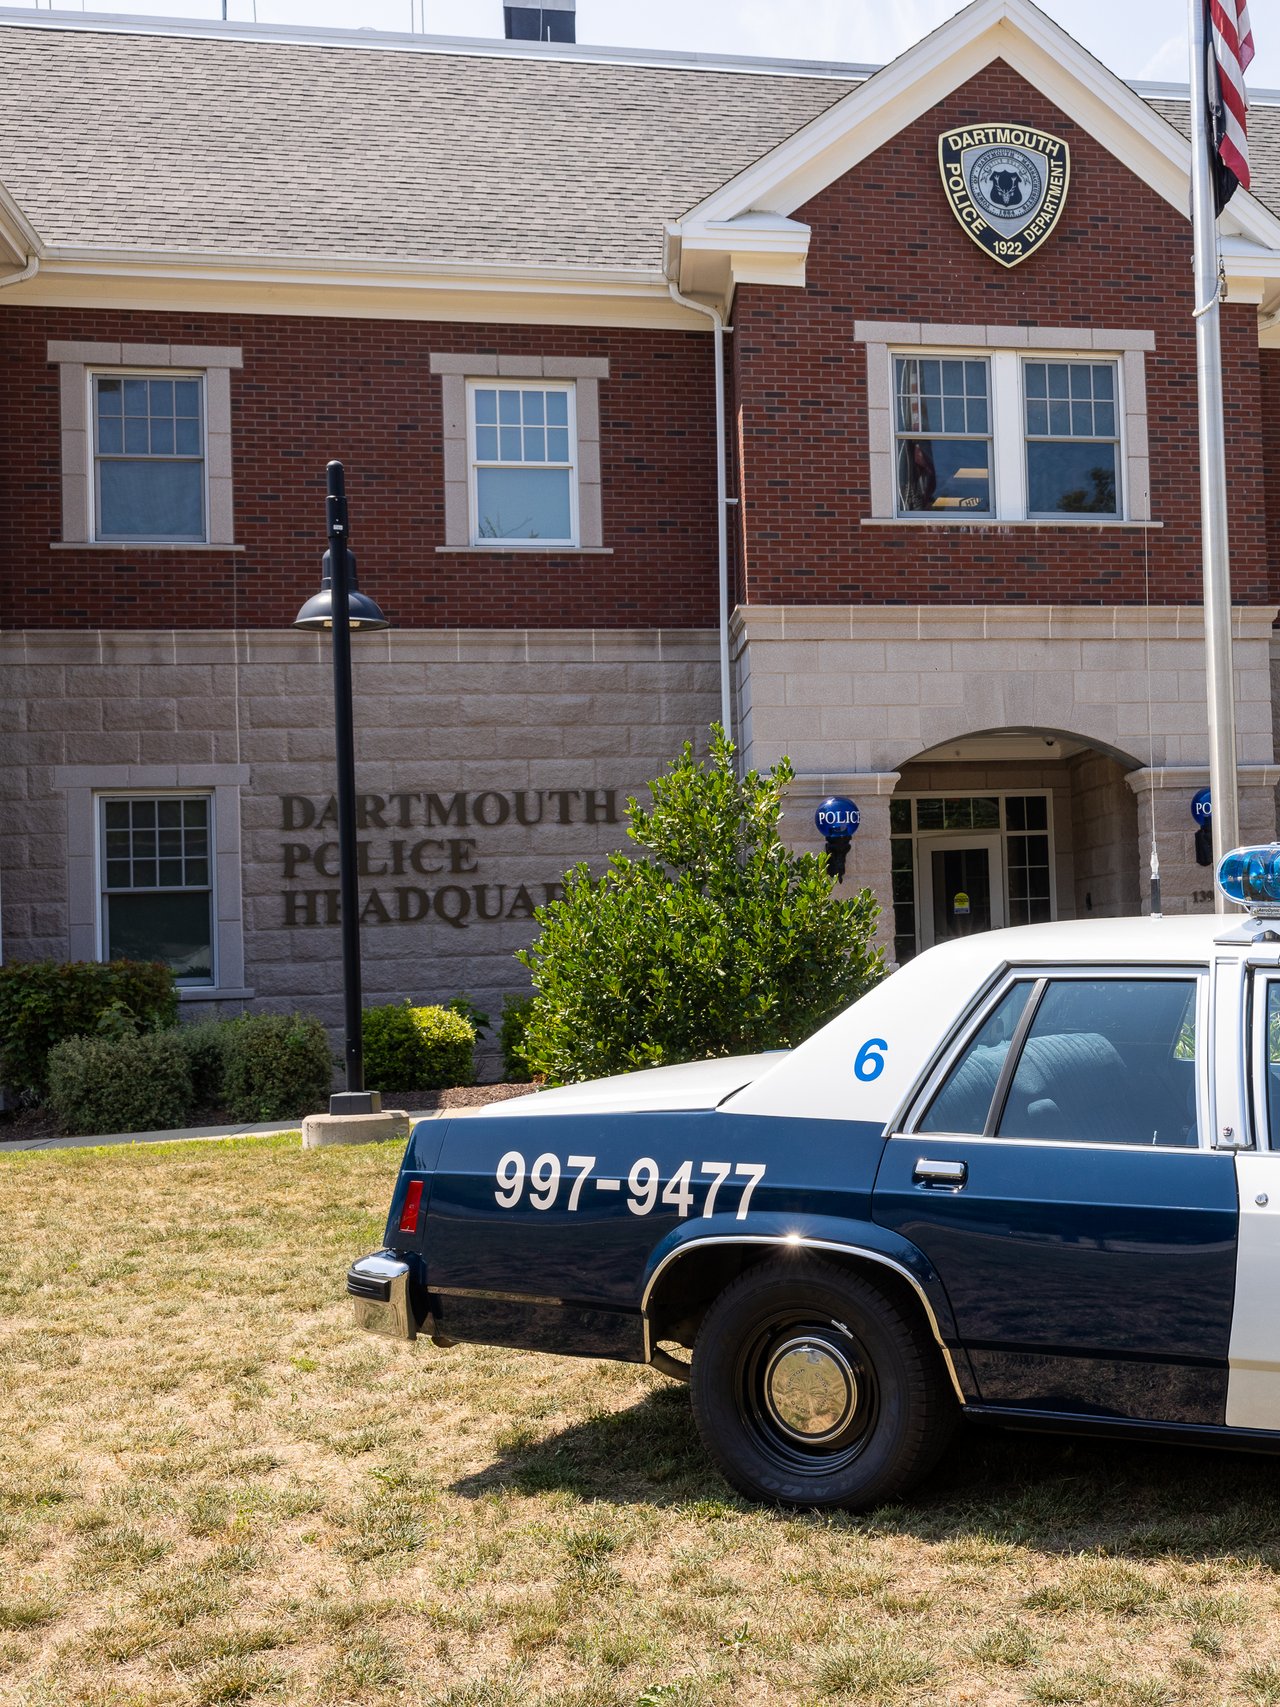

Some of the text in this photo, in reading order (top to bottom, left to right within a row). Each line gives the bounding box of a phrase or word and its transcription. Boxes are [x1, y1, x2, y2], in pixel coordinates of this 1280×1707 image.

[948, 129, 1060, 157] DARTMOUTH
[946, 163, 987, 235] POLICE
[1023, 159, 1063, 243] DEPARTMENT
[993, 241, 1022, 255] 1922
[279, 790, 619, 831] DARTMOUTH
[853, 1037, 889, 1082] 6
[494, 1151, 767, 1220] 997-9477
